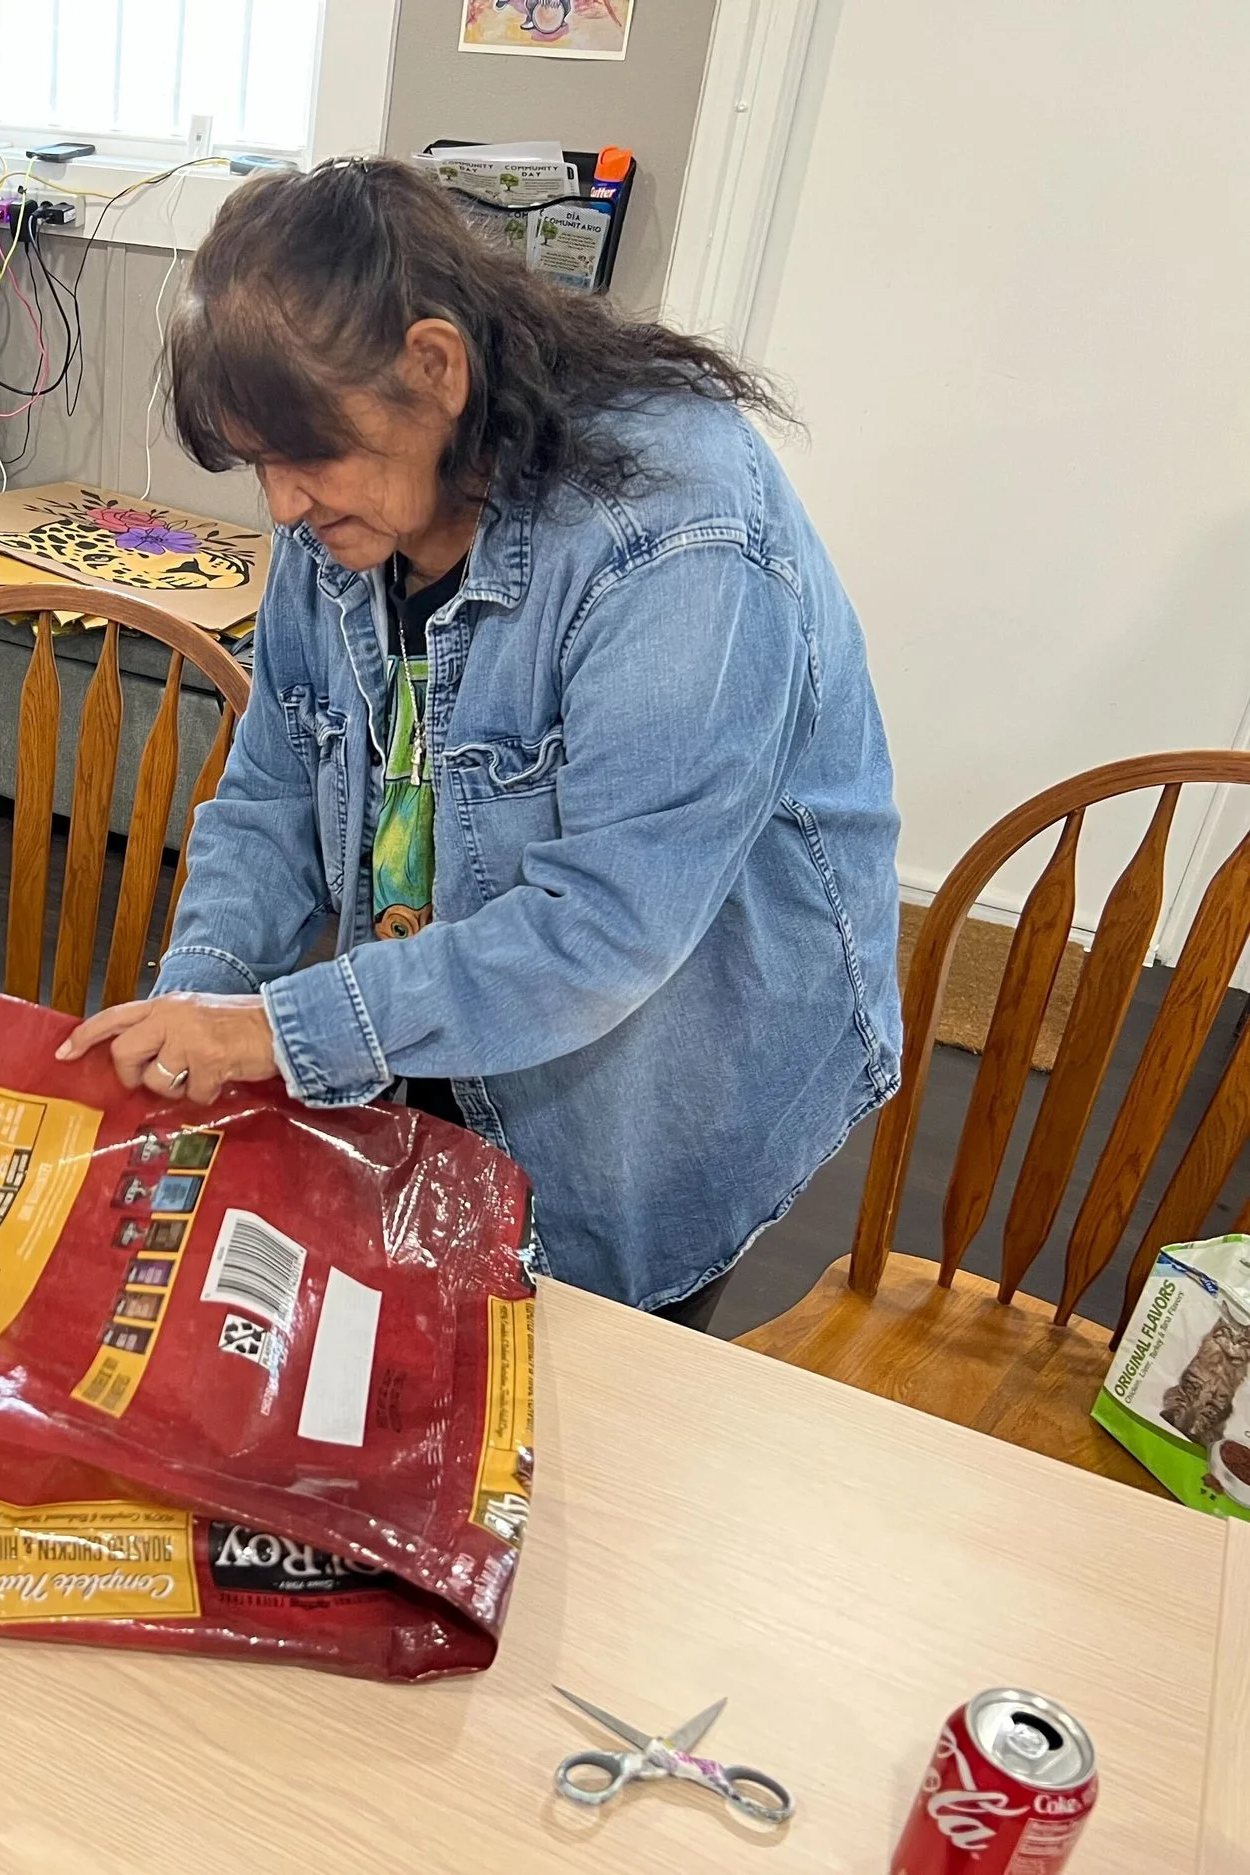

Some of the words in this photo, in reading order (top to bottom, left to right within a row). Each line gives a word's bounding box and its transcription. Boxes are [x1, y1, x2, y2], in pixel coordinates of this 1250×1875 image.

[459, 165, 478, 173] DAY
[544, 216, 602, 233] COMUNITARIO
[1114, 1339, 1151, 1397] ORIGINAL
[1141, 1279, 1176, 1340] FLAVORS
[21, 1536, 32, 1553] &
[50, 1566, 174, 1600] Complete
[1033, 1794, 1083, 1815] Coke
